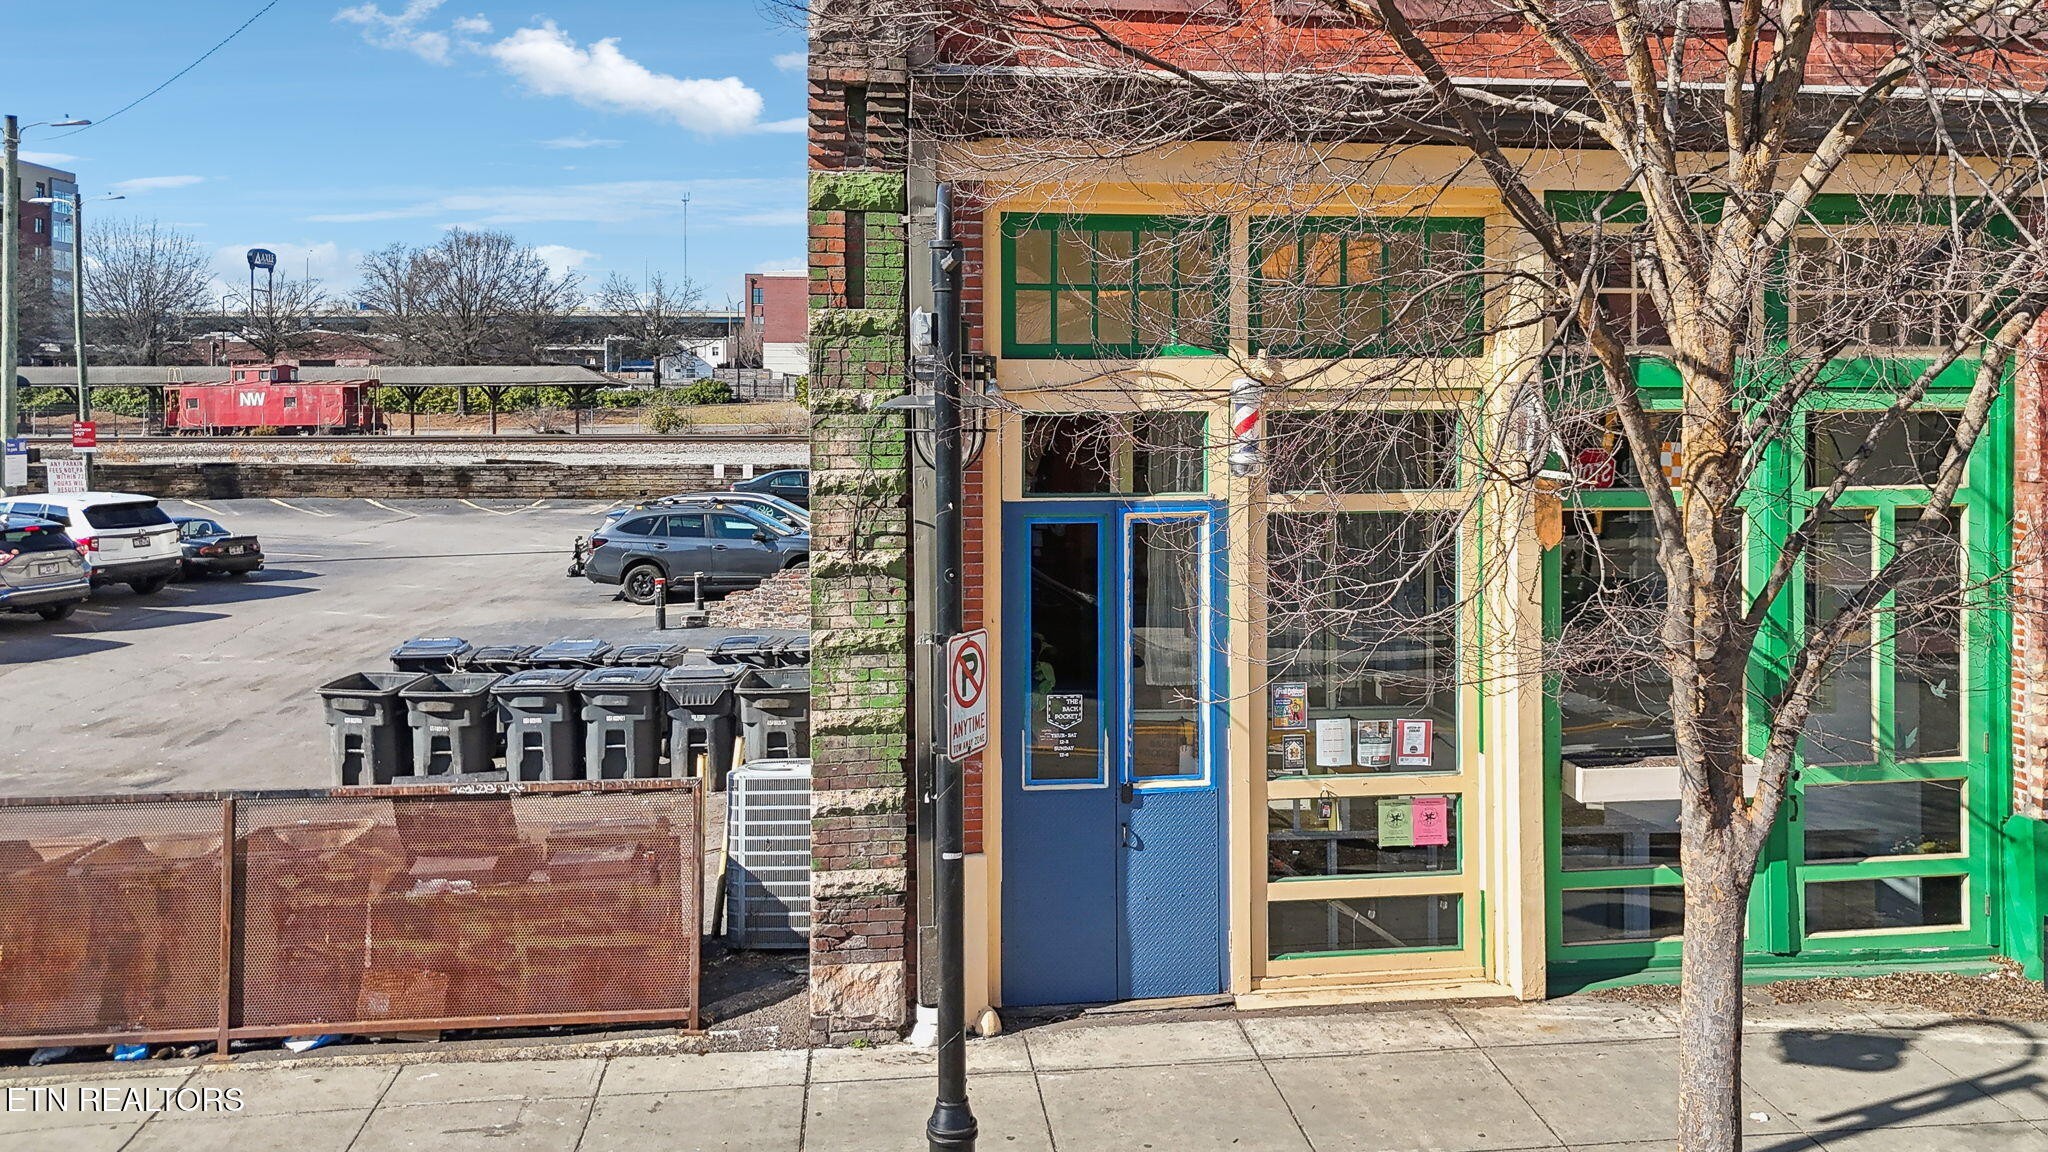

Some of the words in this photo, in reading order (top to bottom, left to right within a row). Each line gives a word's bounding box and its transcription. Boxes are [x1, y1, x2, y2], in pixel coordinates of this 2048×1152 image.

[239, 391, 266, 406] NW
[953, 712, 985, 740] ANYTIME
[953, 743, 962, 754] TOW
